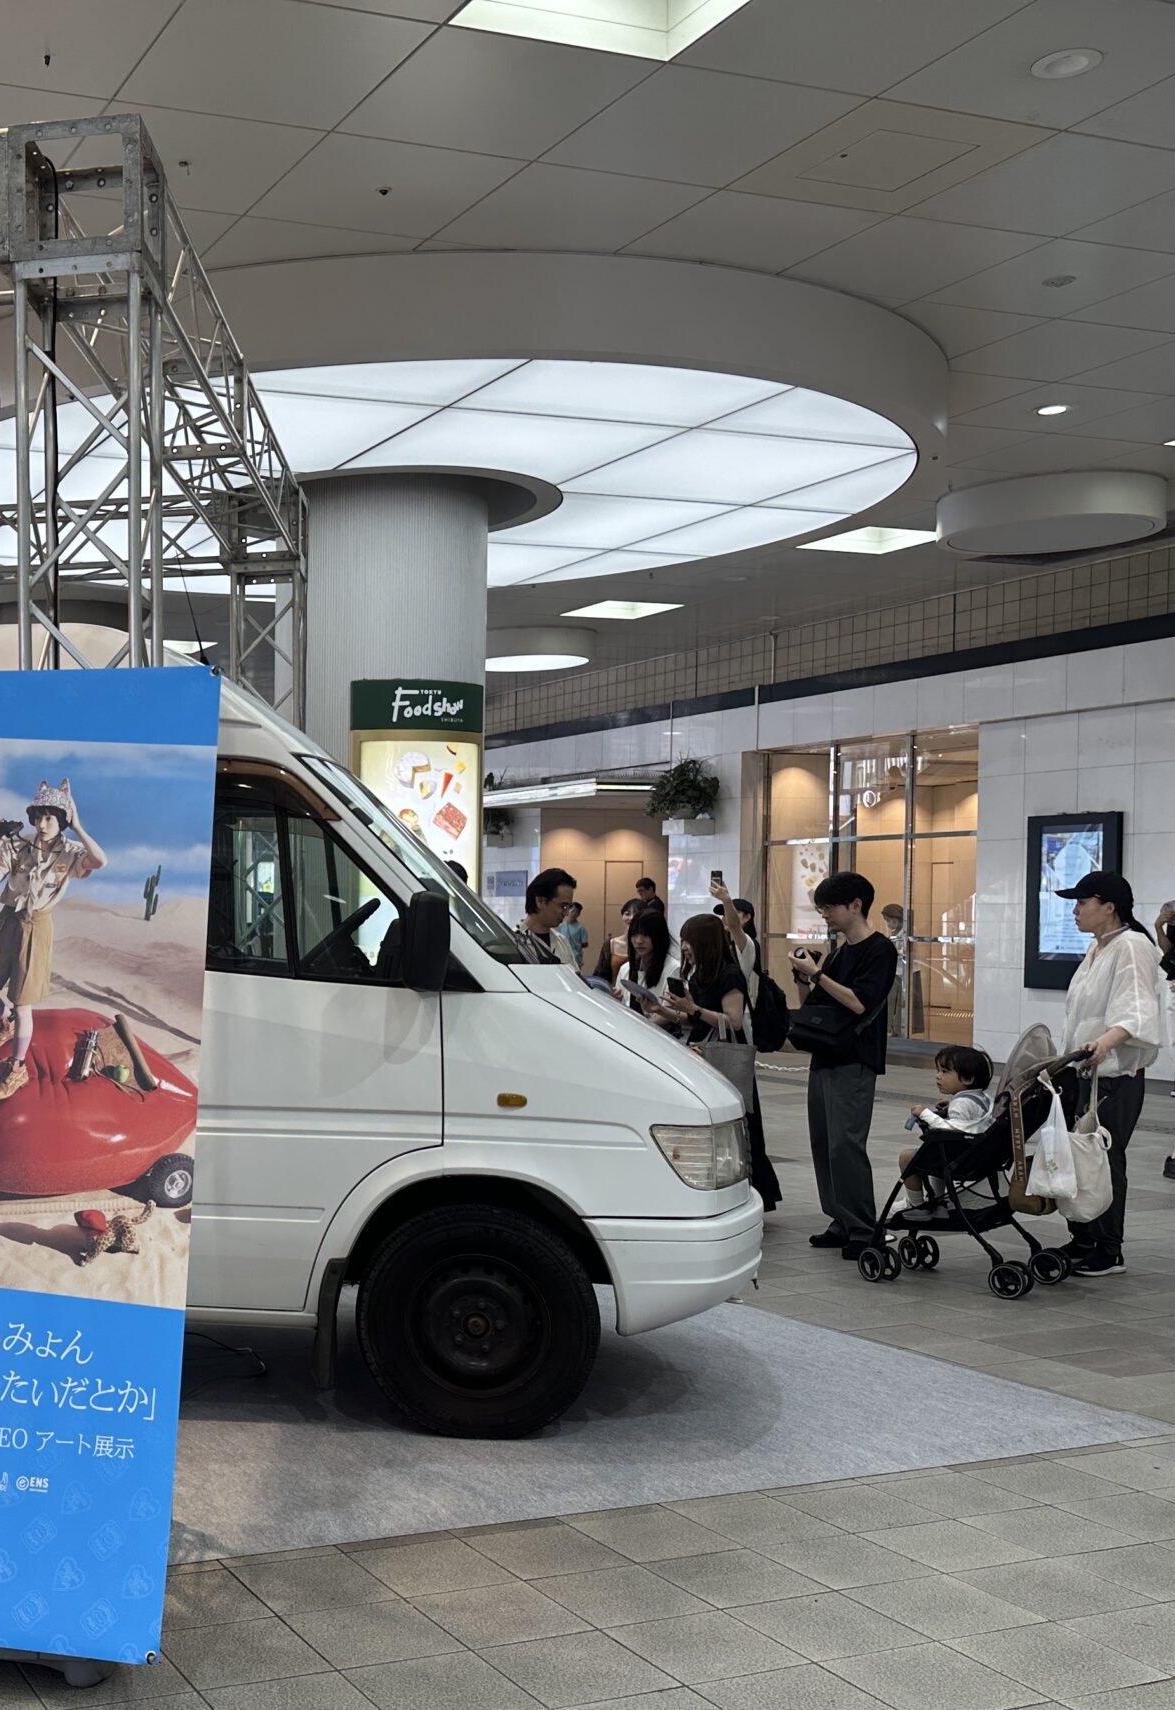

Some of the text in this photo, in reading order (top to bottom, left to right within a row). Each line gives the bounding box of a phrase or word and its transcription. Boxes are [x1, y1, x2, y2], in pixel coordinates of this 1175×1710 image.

[36, 1431, 135, 1460] アート展示
